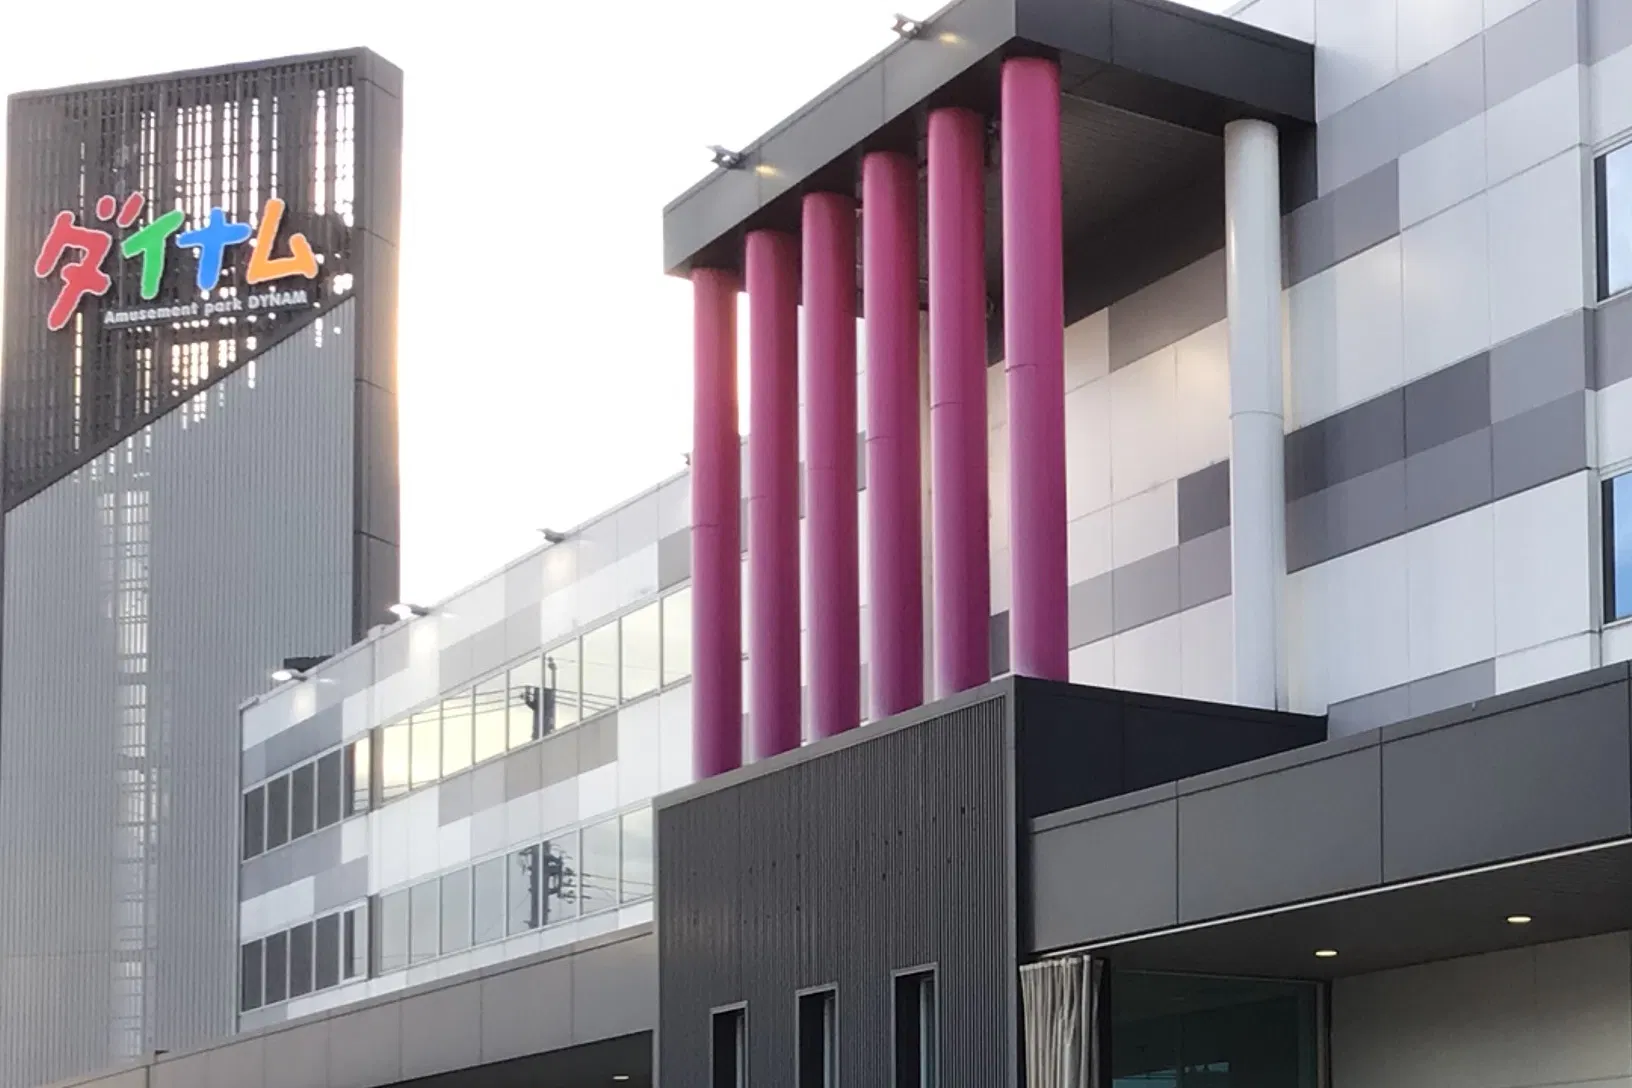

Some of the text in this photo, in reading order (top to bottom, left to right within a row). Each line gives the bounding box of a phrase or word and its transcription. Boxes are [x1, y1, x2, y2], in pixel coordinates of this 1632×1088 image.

[35, 191, 319, 331] ダイナム
[104, 290, 308, 324] Amusement park DYNAM
